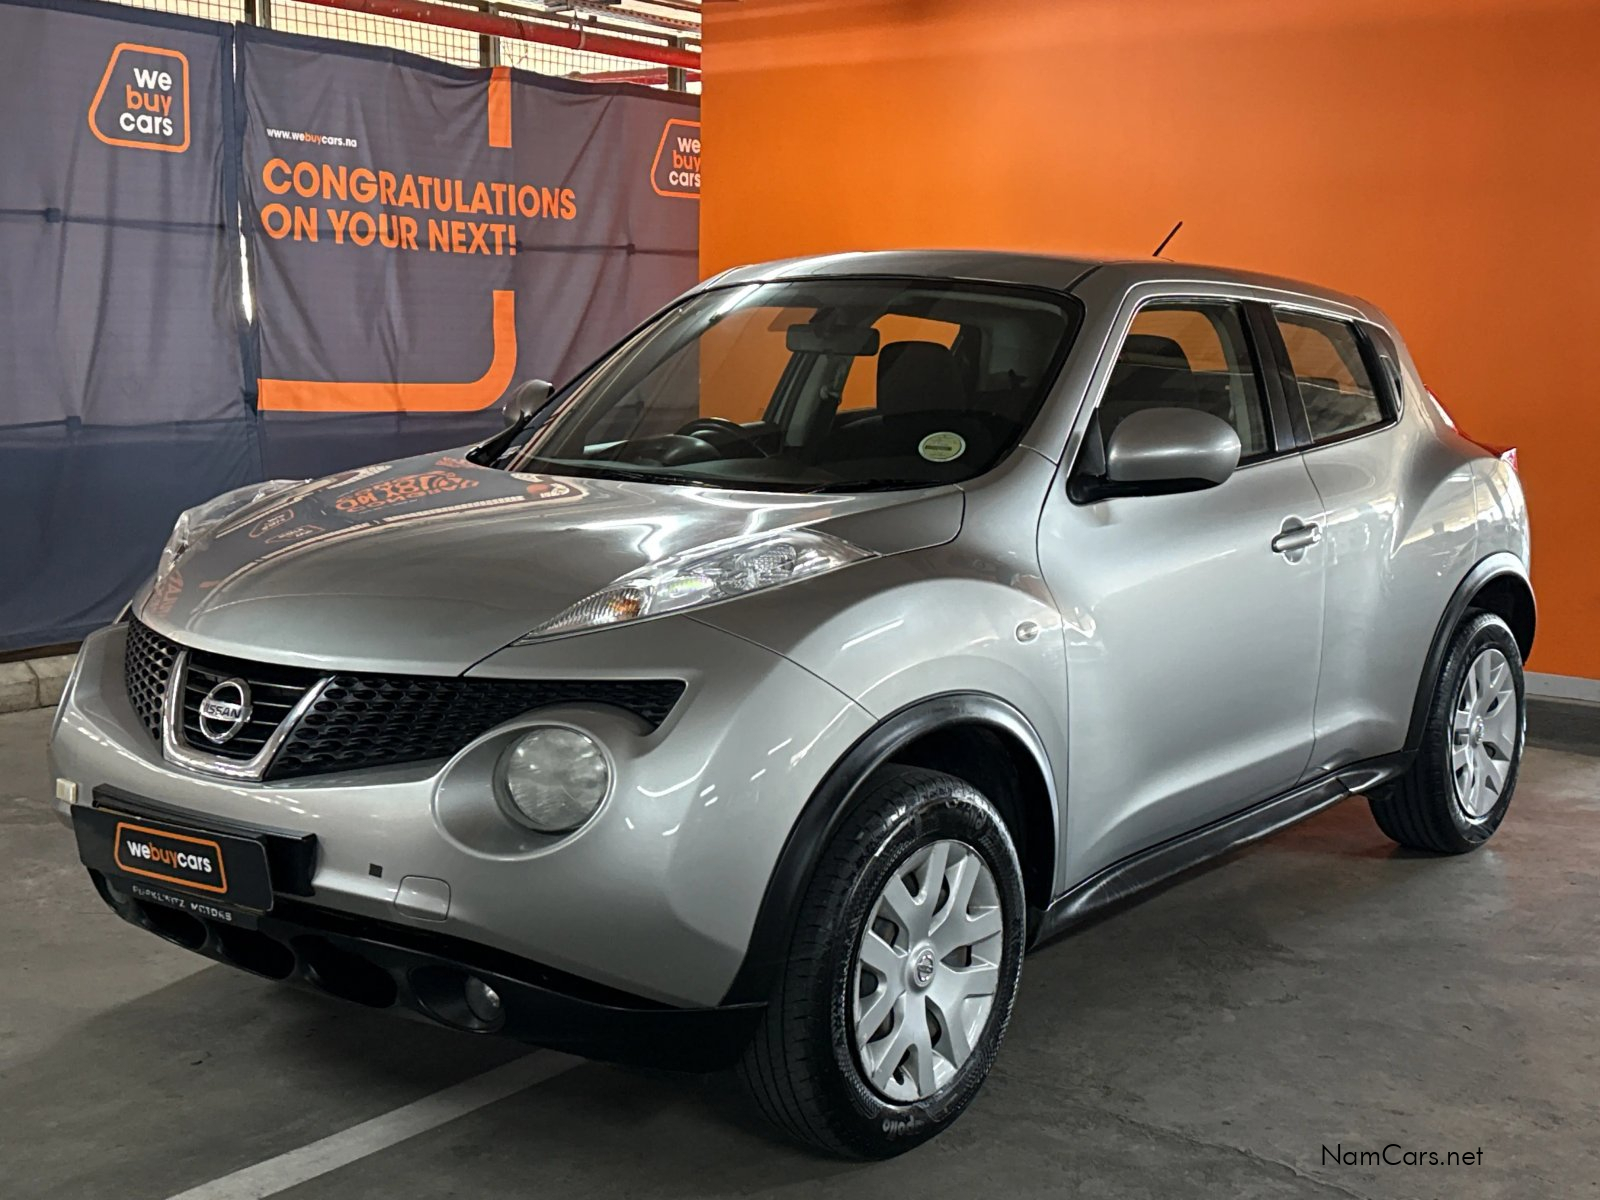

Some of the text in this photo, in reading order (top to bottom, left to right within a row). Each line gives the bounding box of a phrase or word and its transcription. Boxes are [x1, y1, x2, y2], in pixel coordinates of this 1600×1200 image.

[133, 68, 172, 91] we
[126, 84, 172, 116] buy
[119, 112, 173, 136] cars
[266, 128, 357, 148] www.webuycars.na
[677, 137, 701, 153] we
[672, 149, 701, 172] buy
[262, 158, 577, 220] CONGRATULATIONS
[669, 171, 701, 187] cars
[261, 203, 517, 256] ON YOUR NEXT!
[204, 702, 242, 719] NISSAN
[126, 840, 212, 873] webuycars
